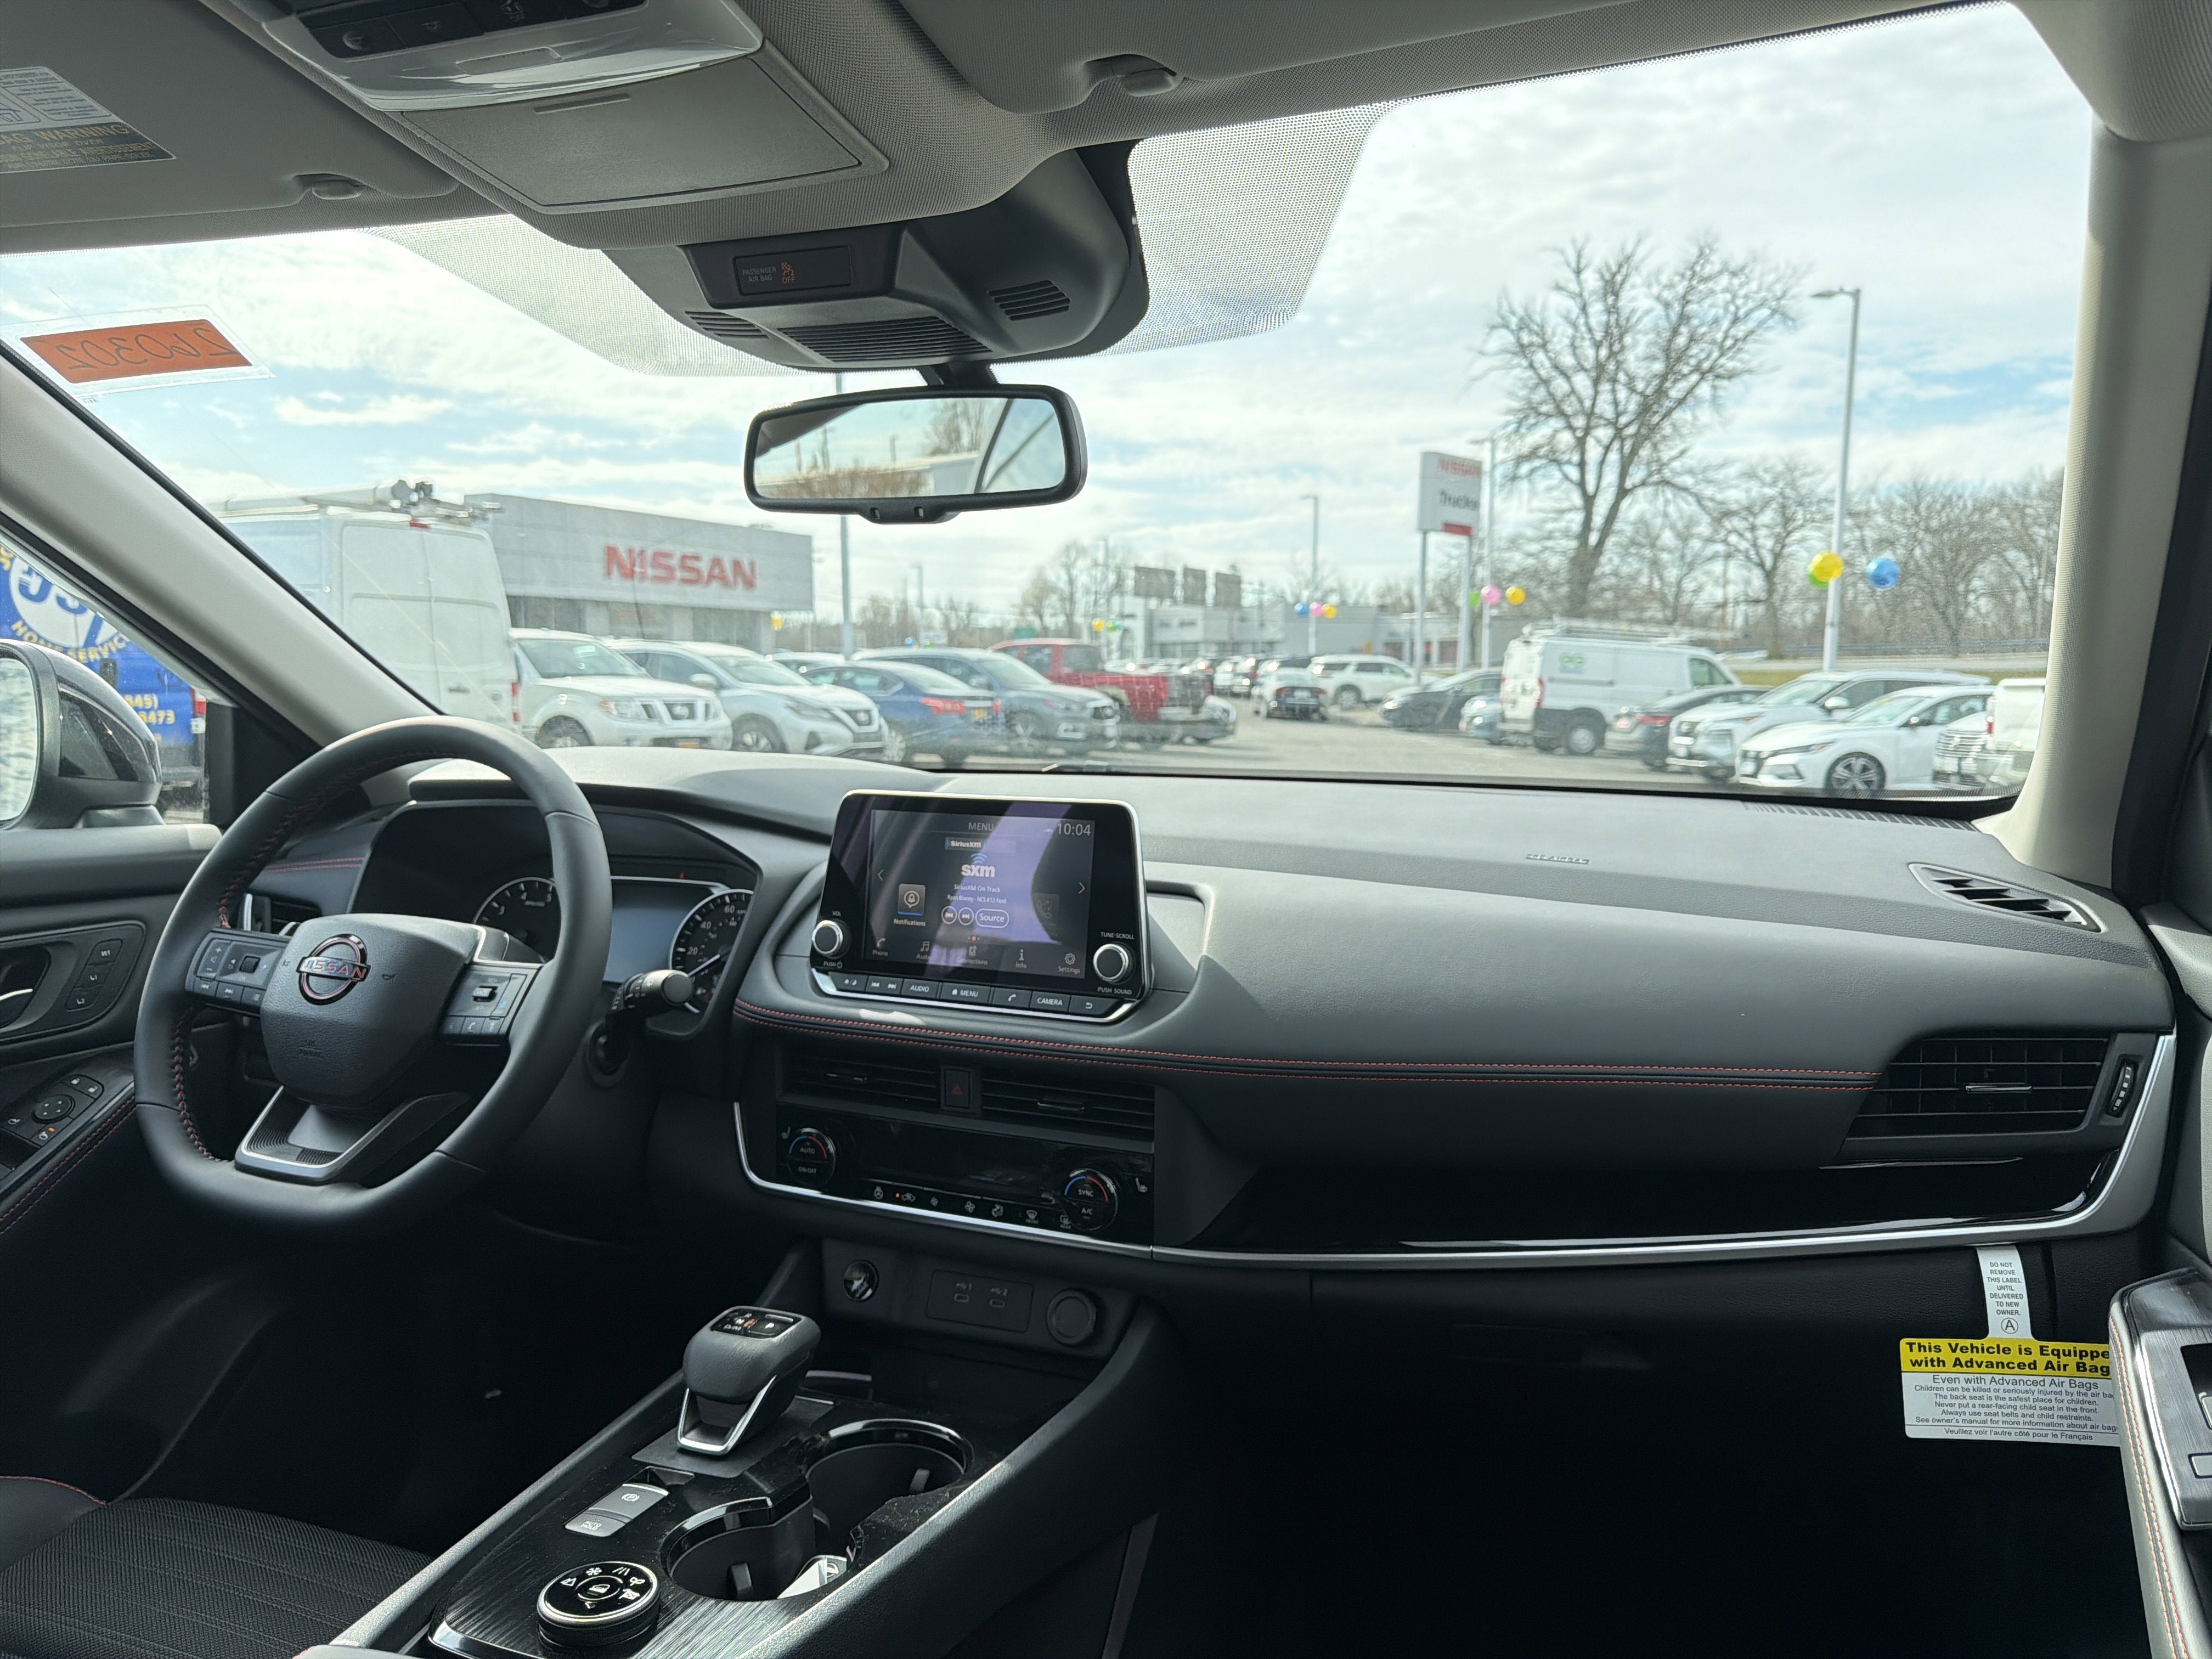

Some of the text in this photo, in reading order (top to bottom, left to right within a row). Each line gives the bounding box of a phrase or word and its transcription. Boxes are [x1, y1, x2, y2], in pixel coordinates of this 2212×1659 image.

[33, 125, 130, 142] WARNING
[742, 267, 777, 275] PASSENGER
[782, 276, 795, 284] OFF
[605, 545, 758, 590] NISSAN
[66, 631, 131, 663] SERVIC
[968, 822, 994, 831] MENU
[1057, 823, 1091, 836] 10:04
[724, 905, 735, 913] 60
[979, 912, 1005, 923] Source
[700, 921, 712, 930] 40
[894, 918, 926, 927] Notifications
[687, 946, 698, 956] 20
[956, 956, 988, 966] Connections
[302, 960, 367, 978] NISSAN
[1058, 966, 1081, 975] Settings
[910, 984, 930, 992] AUDIO
[1037, 997, 1063, 1006] CAMERA
[1078, 1189, 1094, 1197] SYNC
[1081, 1207, 1093, 1215] A/C
[1905, 1341, 2110, 1361] This Vehicle is Equippe
[1909, 1357, 2111, 1376] with Advanced Air Bag
[1932, 1374, 2099, 1391] Even with Advanced Air Bags
[2002, 1387, 2035, 1396] seriously
[2065, 1390, 2074, 1398] by
[1978, 1402, 2017, 1410] rear-facing
[1941, 1409, 1967, 1418] Always
[2022, 1420, 2064, 1429] information
[2061, 1433, 2094, 1441] Français
